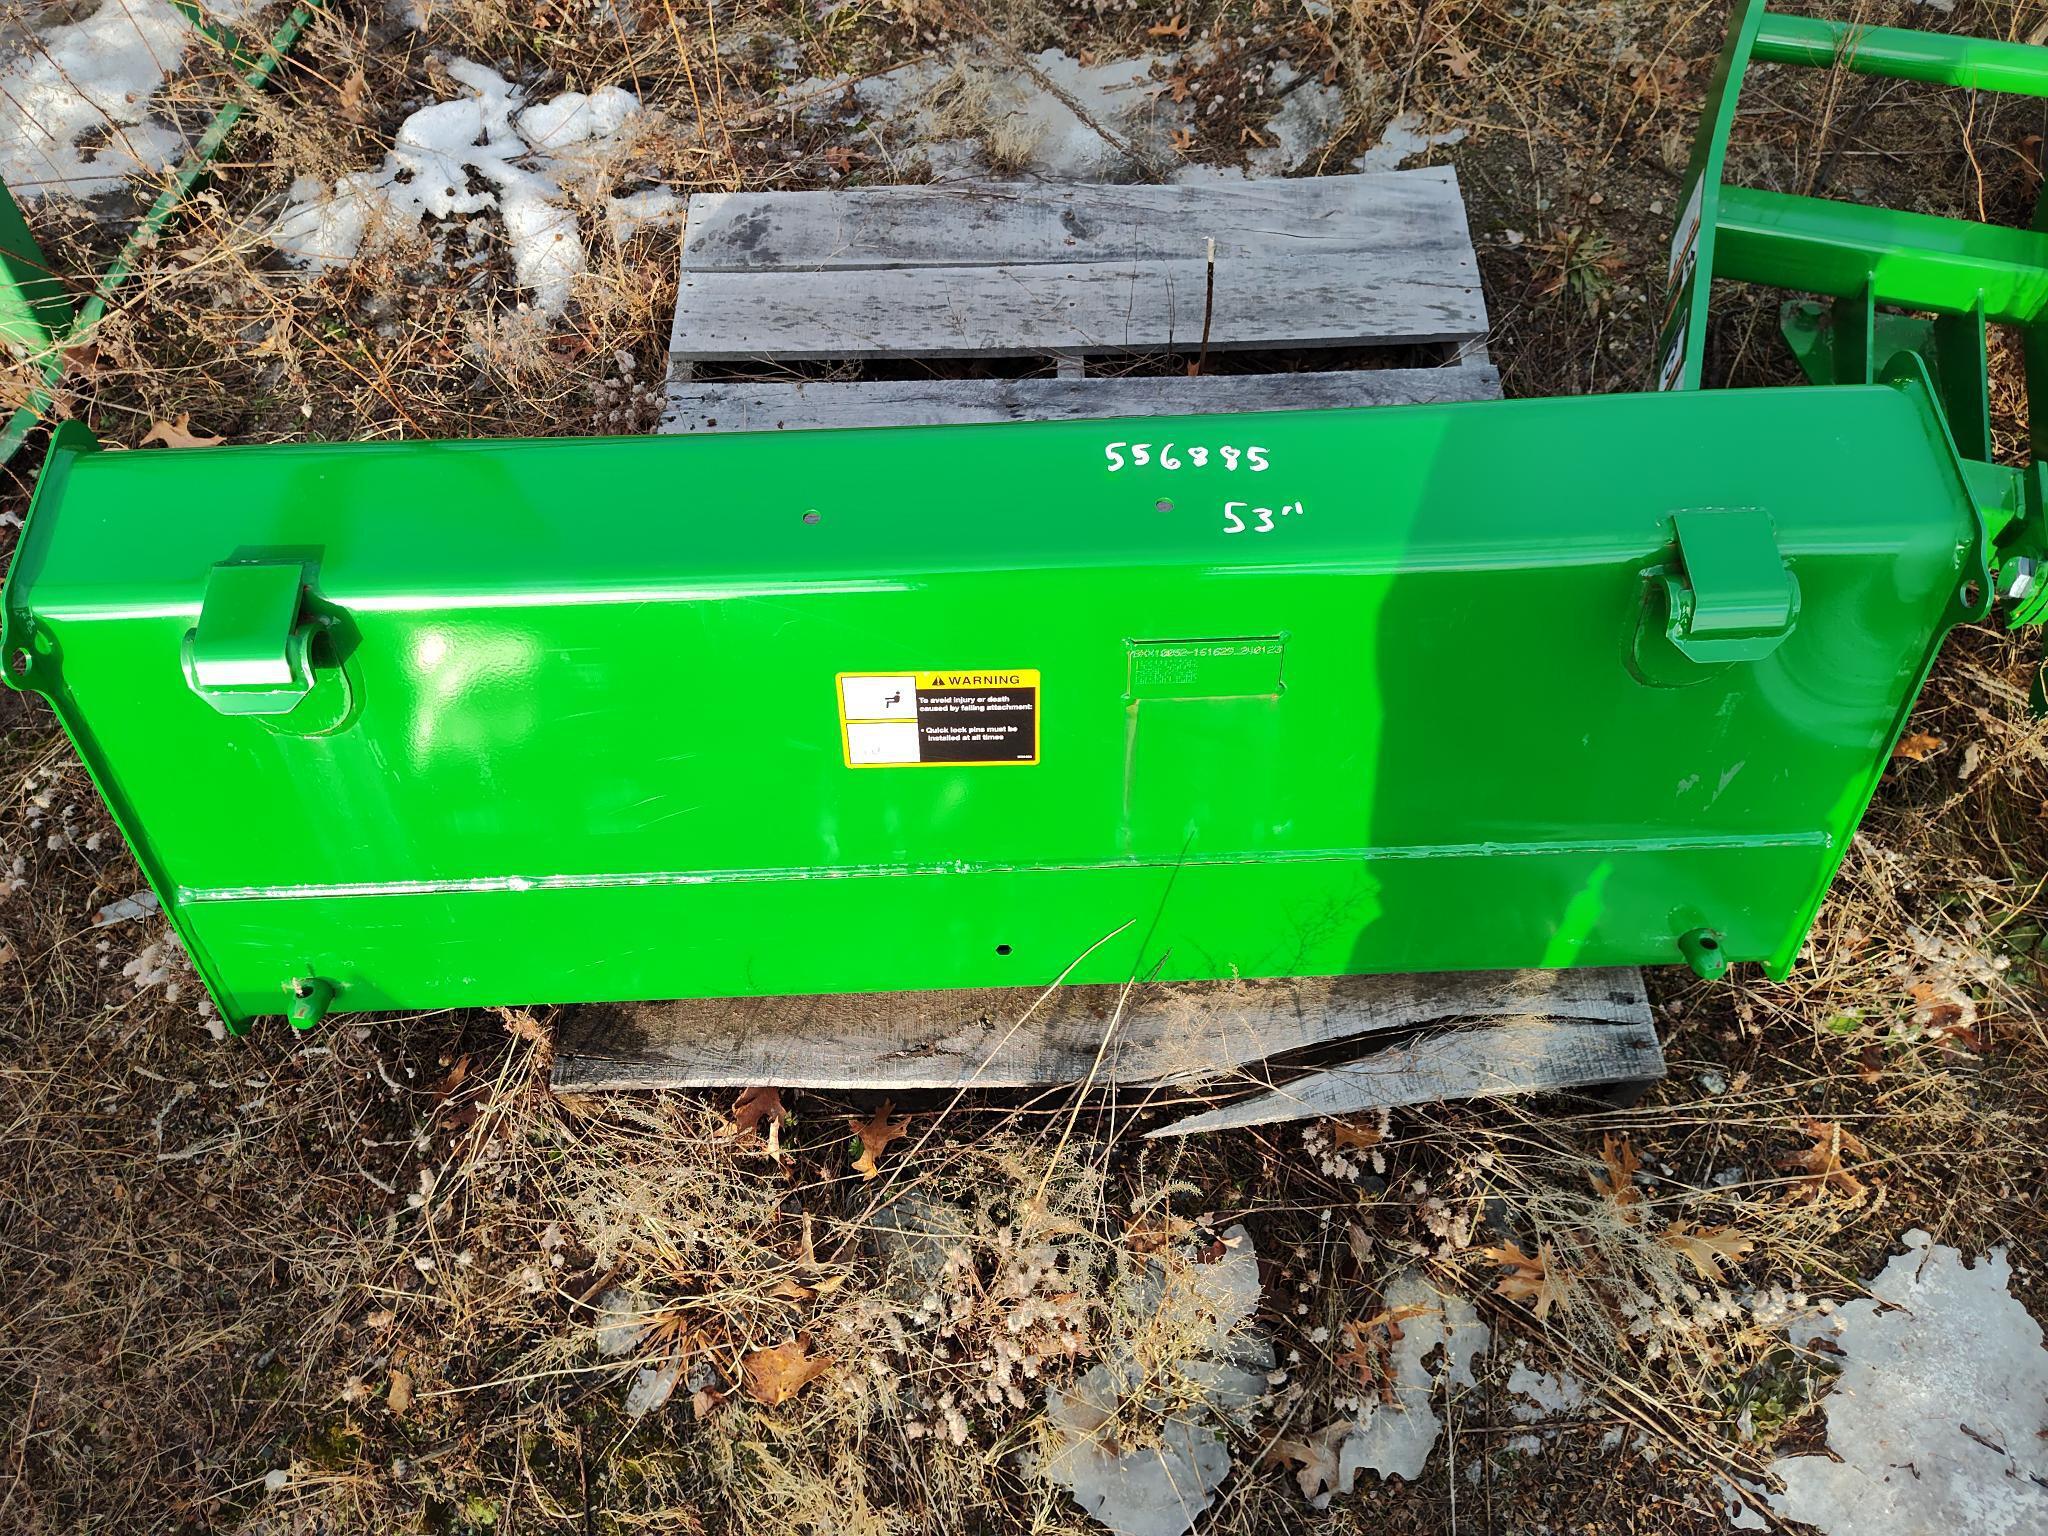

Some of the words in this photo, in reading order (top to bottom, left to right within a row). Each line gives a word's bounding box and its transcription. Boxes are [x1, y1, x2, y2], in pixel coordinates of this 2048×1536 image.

[1105, 442, 1270, 472] 556885
[949, 675, 1020, 685] WARNING
[930, 696, 952, 704] avoid
[953, 696, 975, 705] injury
[949, 705, 960, 713] by
[961, 704, 985, 713] falling
[968, 726, 985, 734] pins
[982, 733, 1005, 741] times
